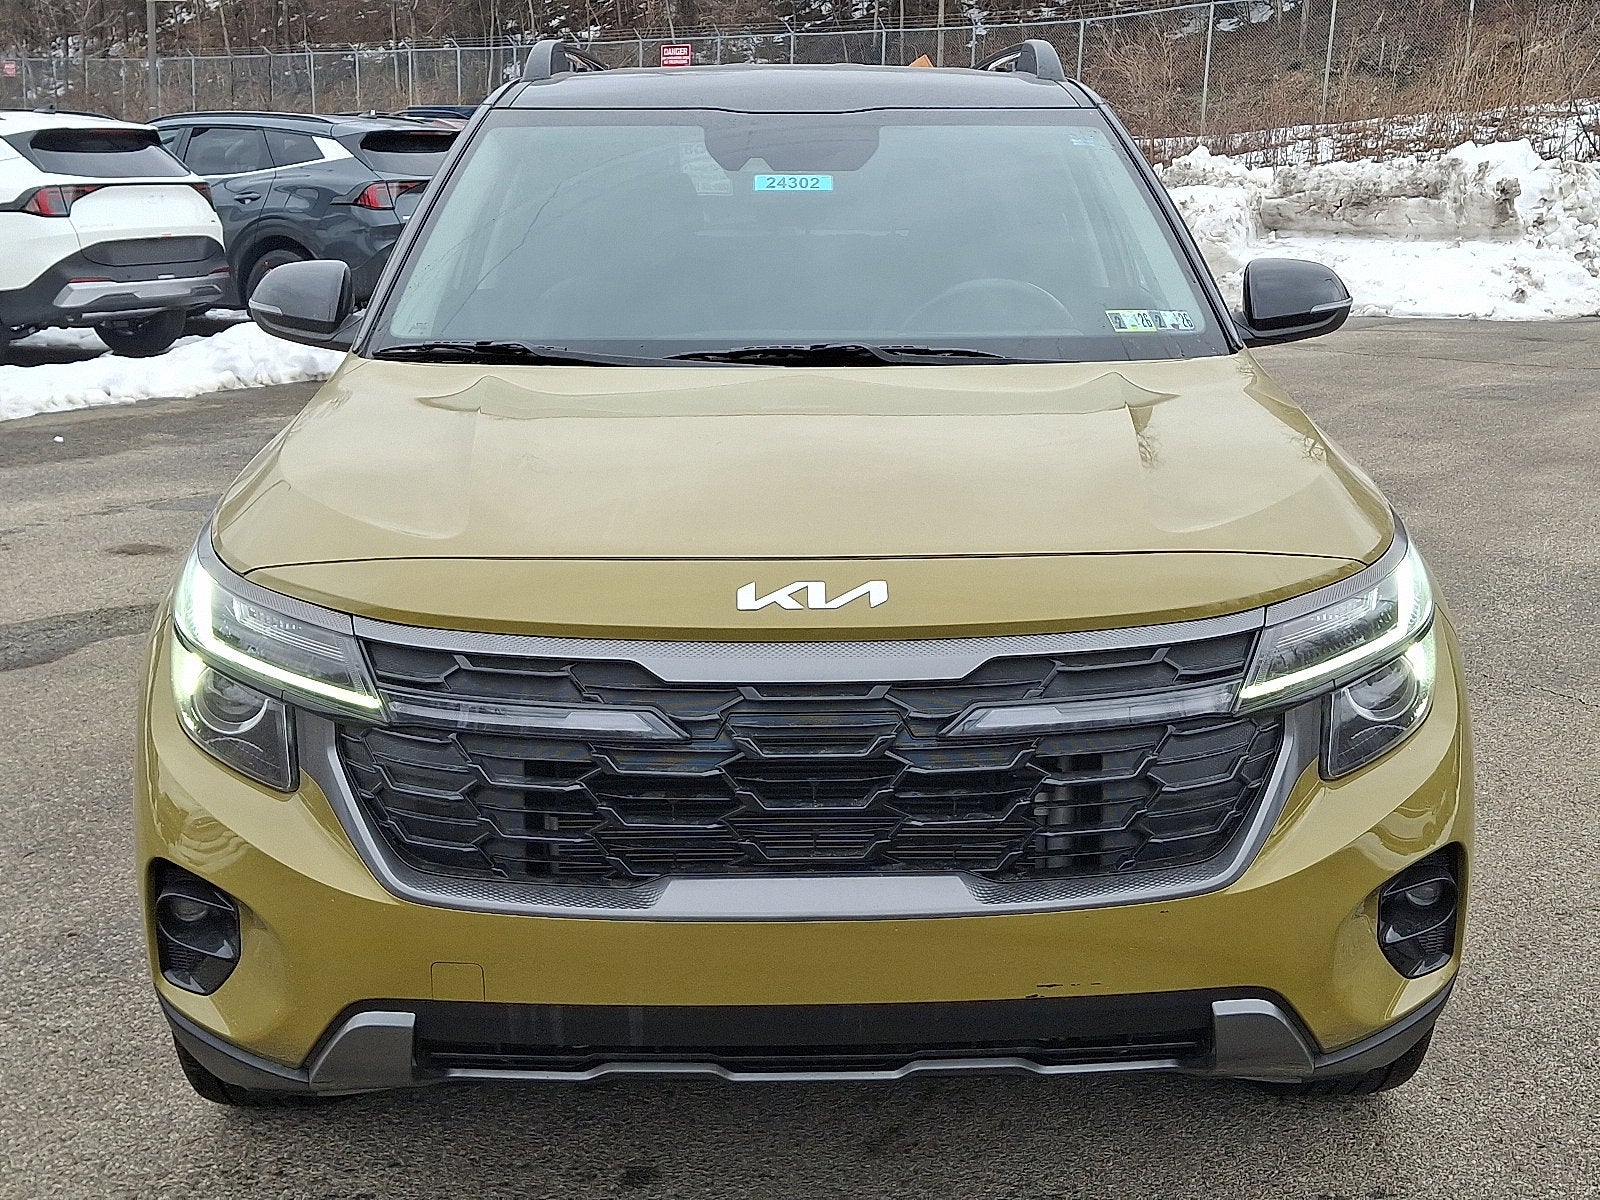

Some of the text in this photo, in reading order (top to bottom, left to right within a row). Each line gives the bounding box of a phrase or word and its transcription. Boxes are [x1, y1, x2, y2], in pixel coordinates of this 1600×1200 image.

[663, 47, 688, 56] DANGER
[765, 177, 820, 189] 24302
[1137, 312, 1153, 328] 26
[1178, 312, 1194, 328] 26
[736, 580, 889, 611] KIA
